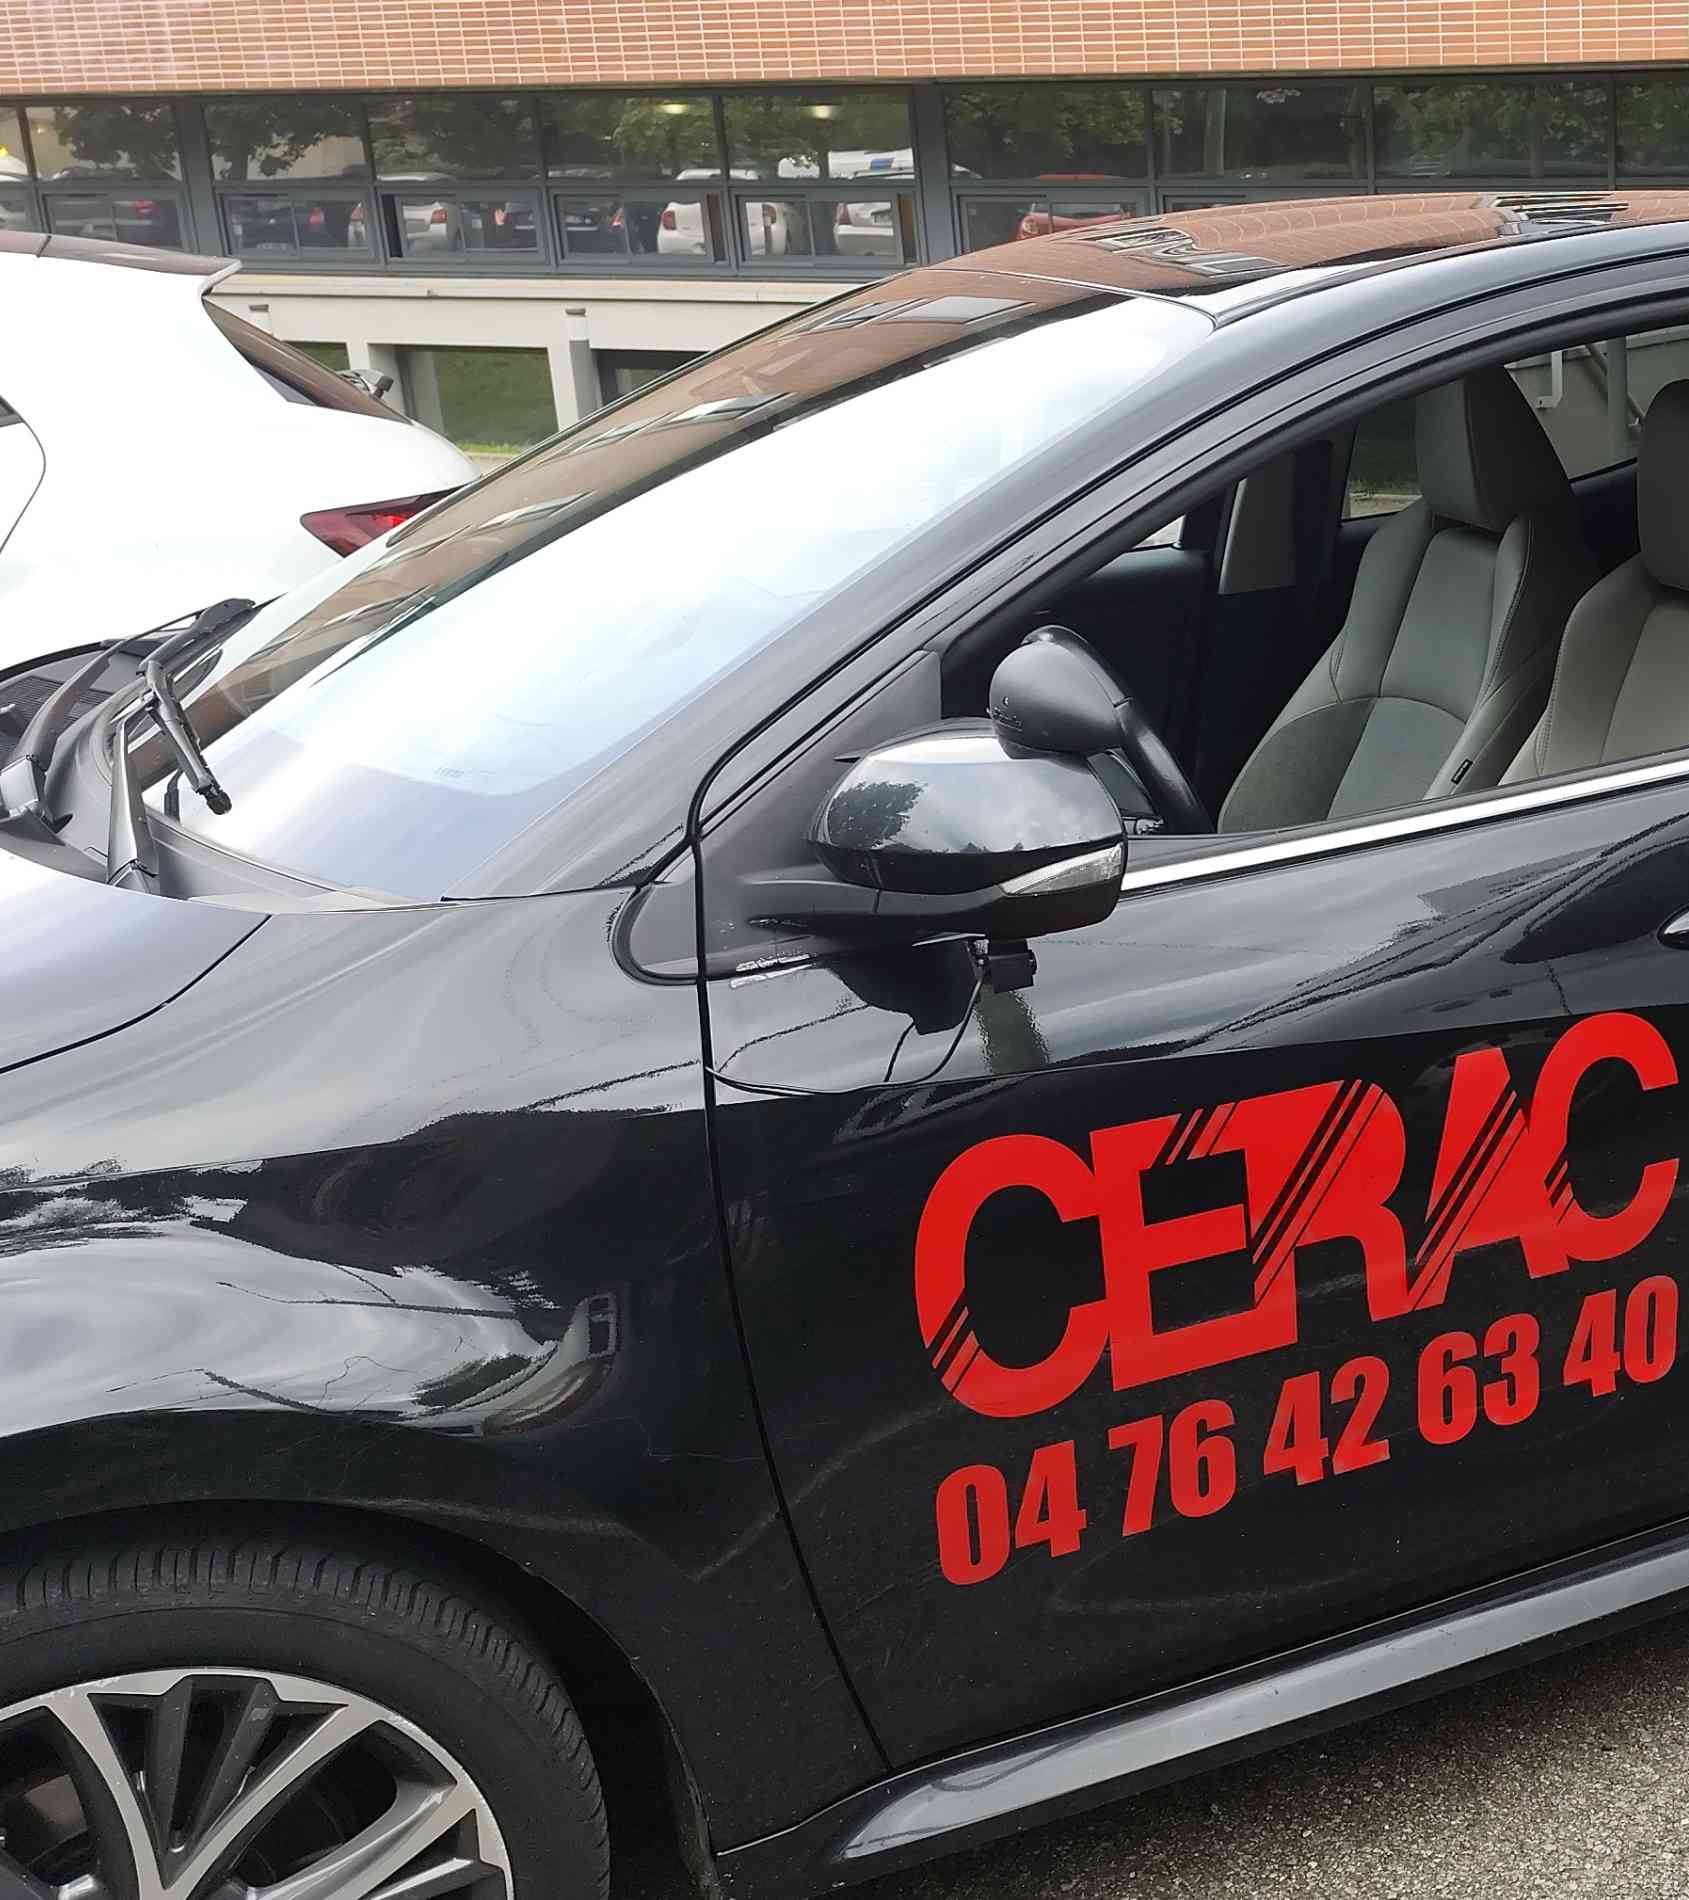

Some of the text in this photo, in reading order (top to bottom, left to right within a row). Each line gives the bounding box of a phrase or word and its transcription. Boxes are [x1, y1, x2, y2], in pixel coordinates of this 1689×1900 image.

[914, 1011, 1680, 1418] CERAC
[935, 1275, 1680, 1584] 04 76 42 63 40
